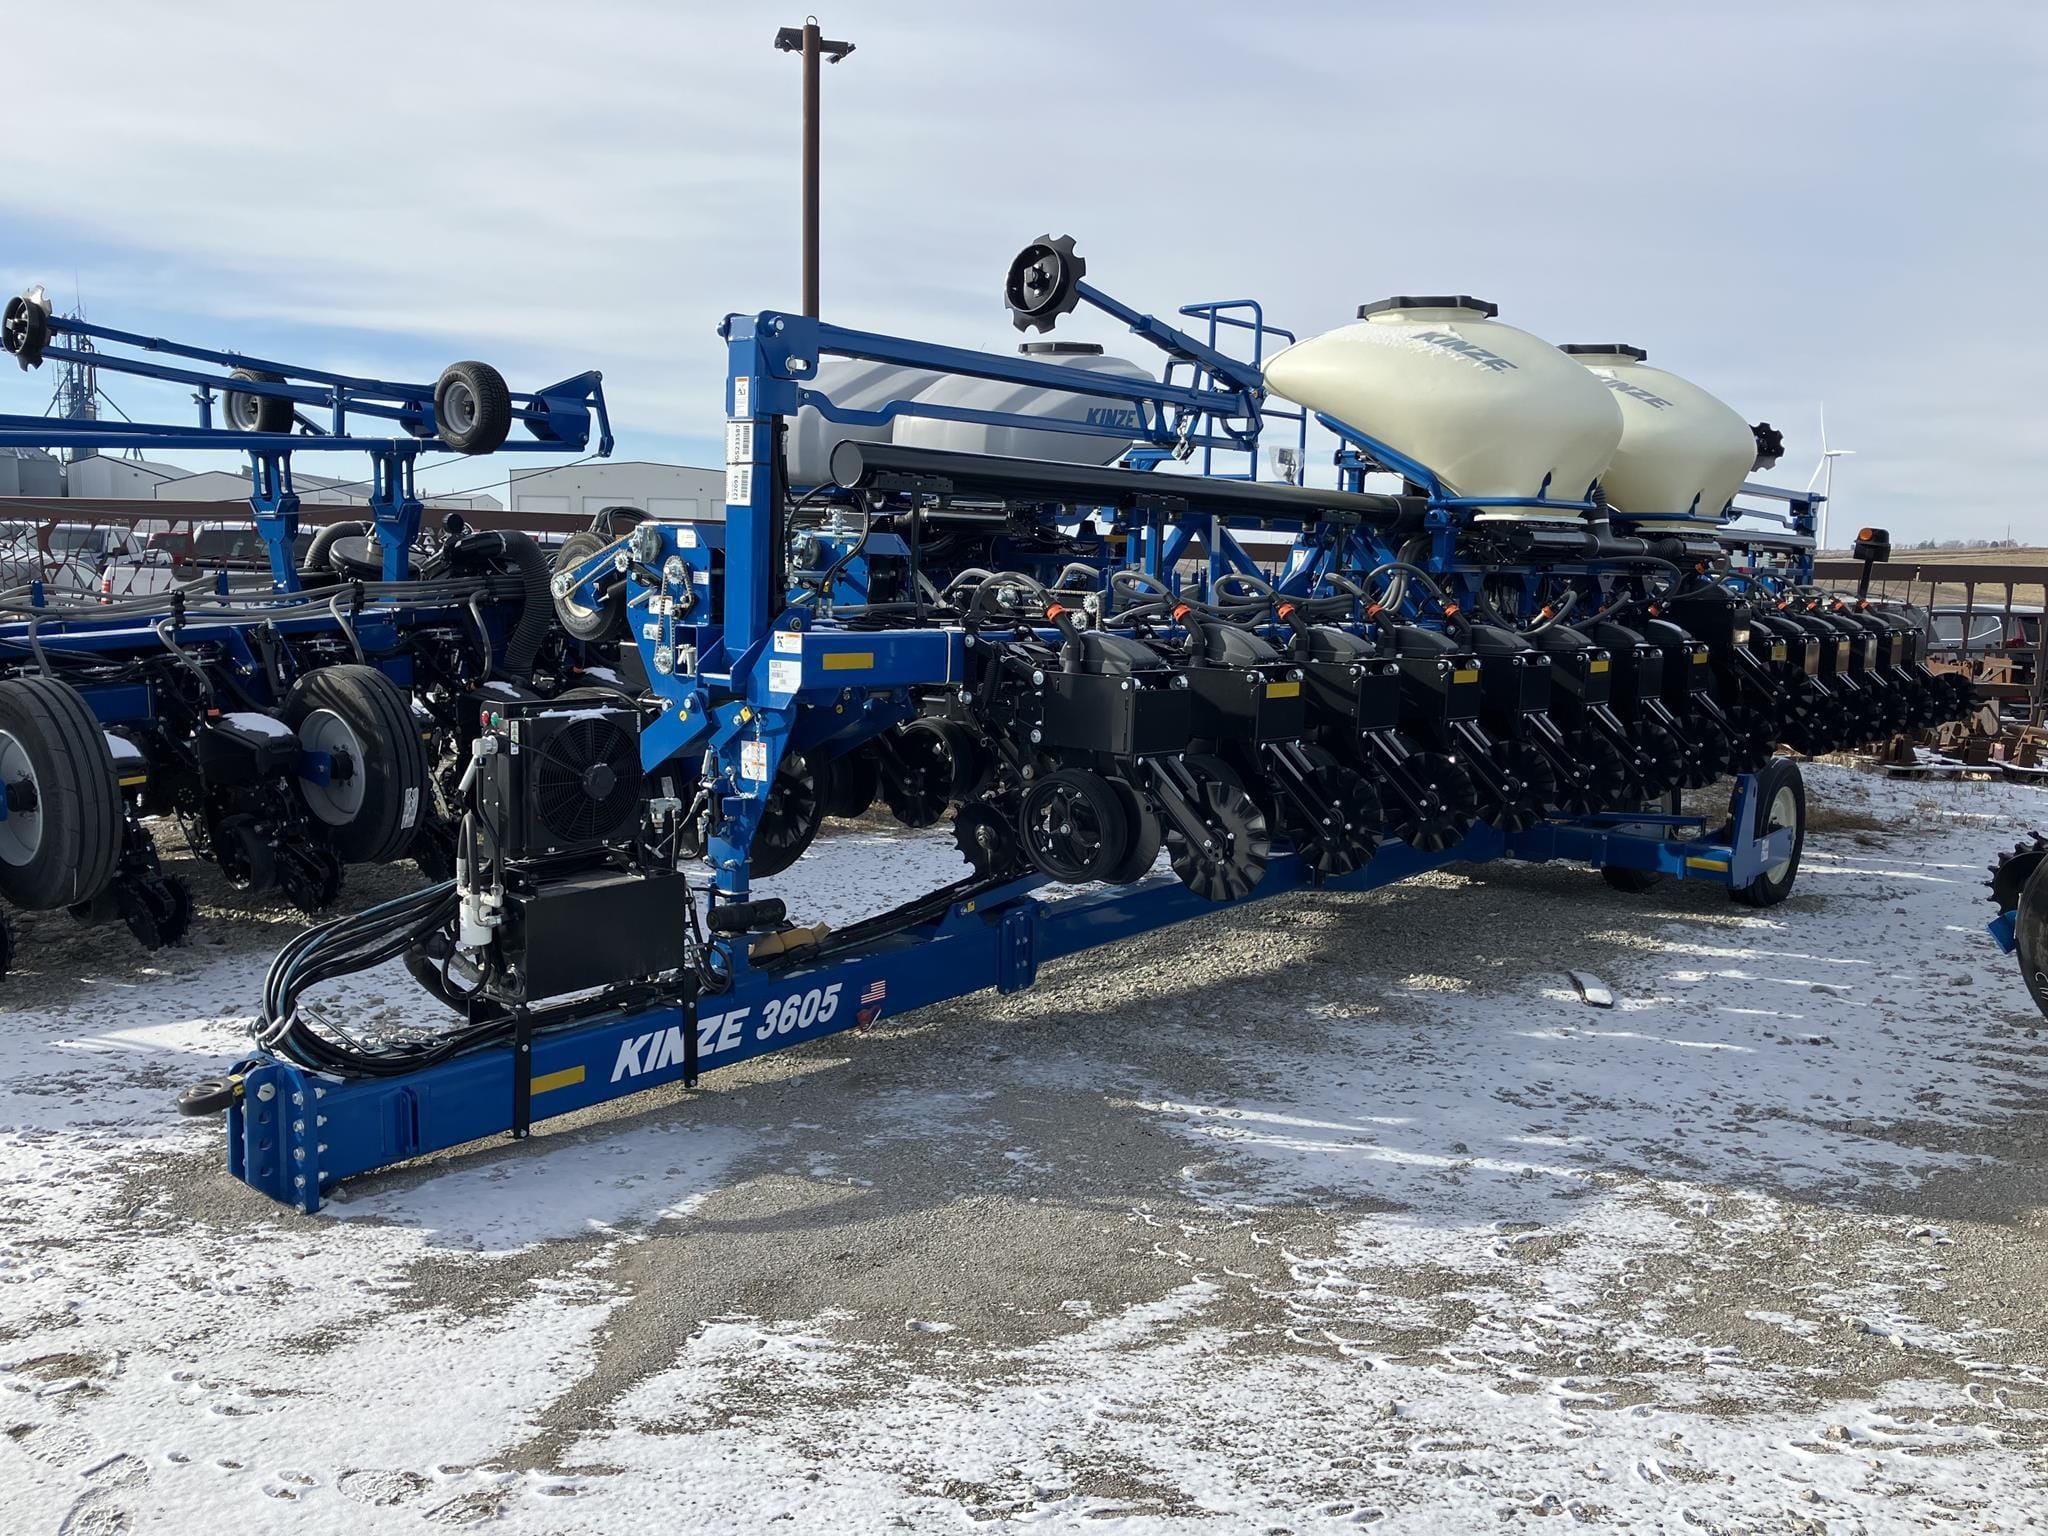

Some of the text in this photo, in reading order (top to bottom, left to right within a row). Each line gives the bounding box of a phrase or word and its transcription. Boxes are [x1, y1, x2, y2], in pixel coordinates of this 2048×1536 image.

[1409, 331, 1519, 371] KINZE
[1086, 407, 1137, 428] KINZE
[610, 982, 844, 1083] KINZE 3605
